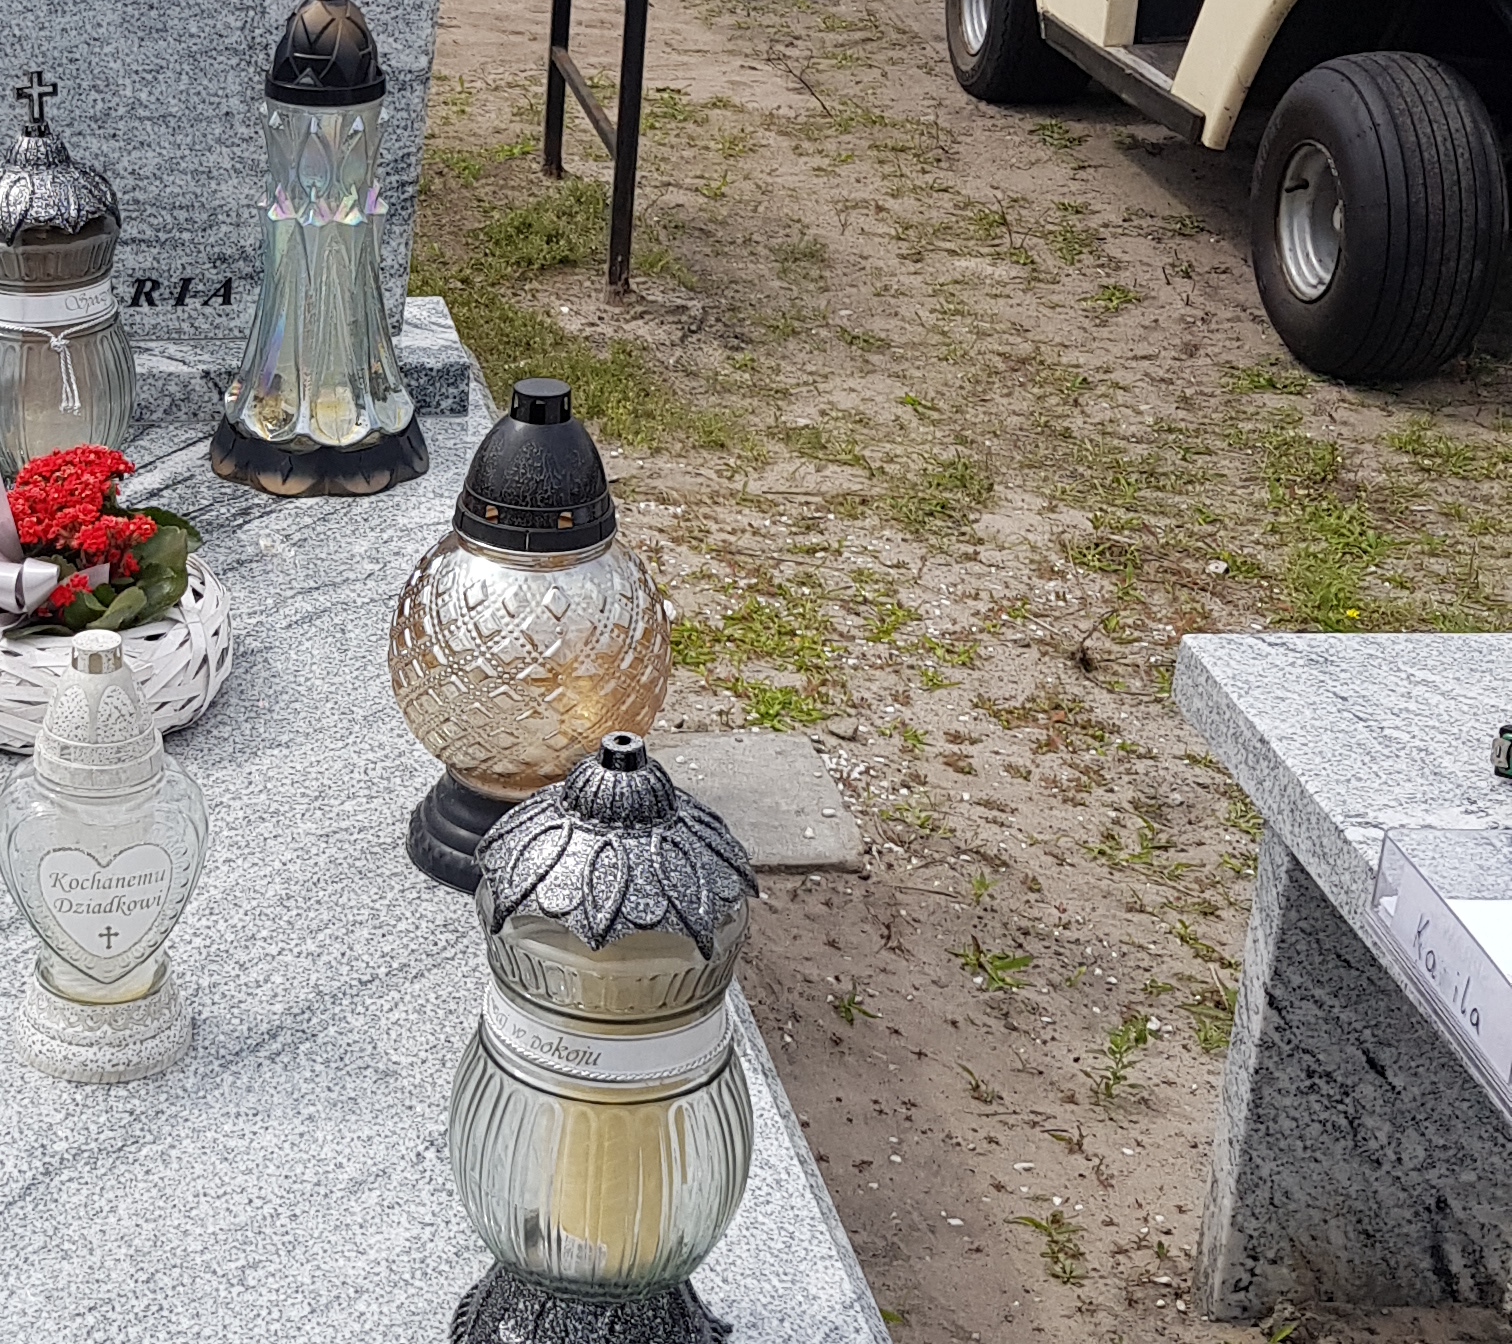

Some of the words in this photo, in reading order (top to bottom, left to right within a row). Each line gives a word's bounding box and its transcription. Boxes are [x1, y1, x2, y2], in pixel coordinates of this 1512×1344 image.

[128, 276, 233, 309] RIA
[48, 867, 167, 893] Kochanemu
[53, 889, 165, 917] Dziadkowi
[1411, 914, 1481, 1037] Kaila
